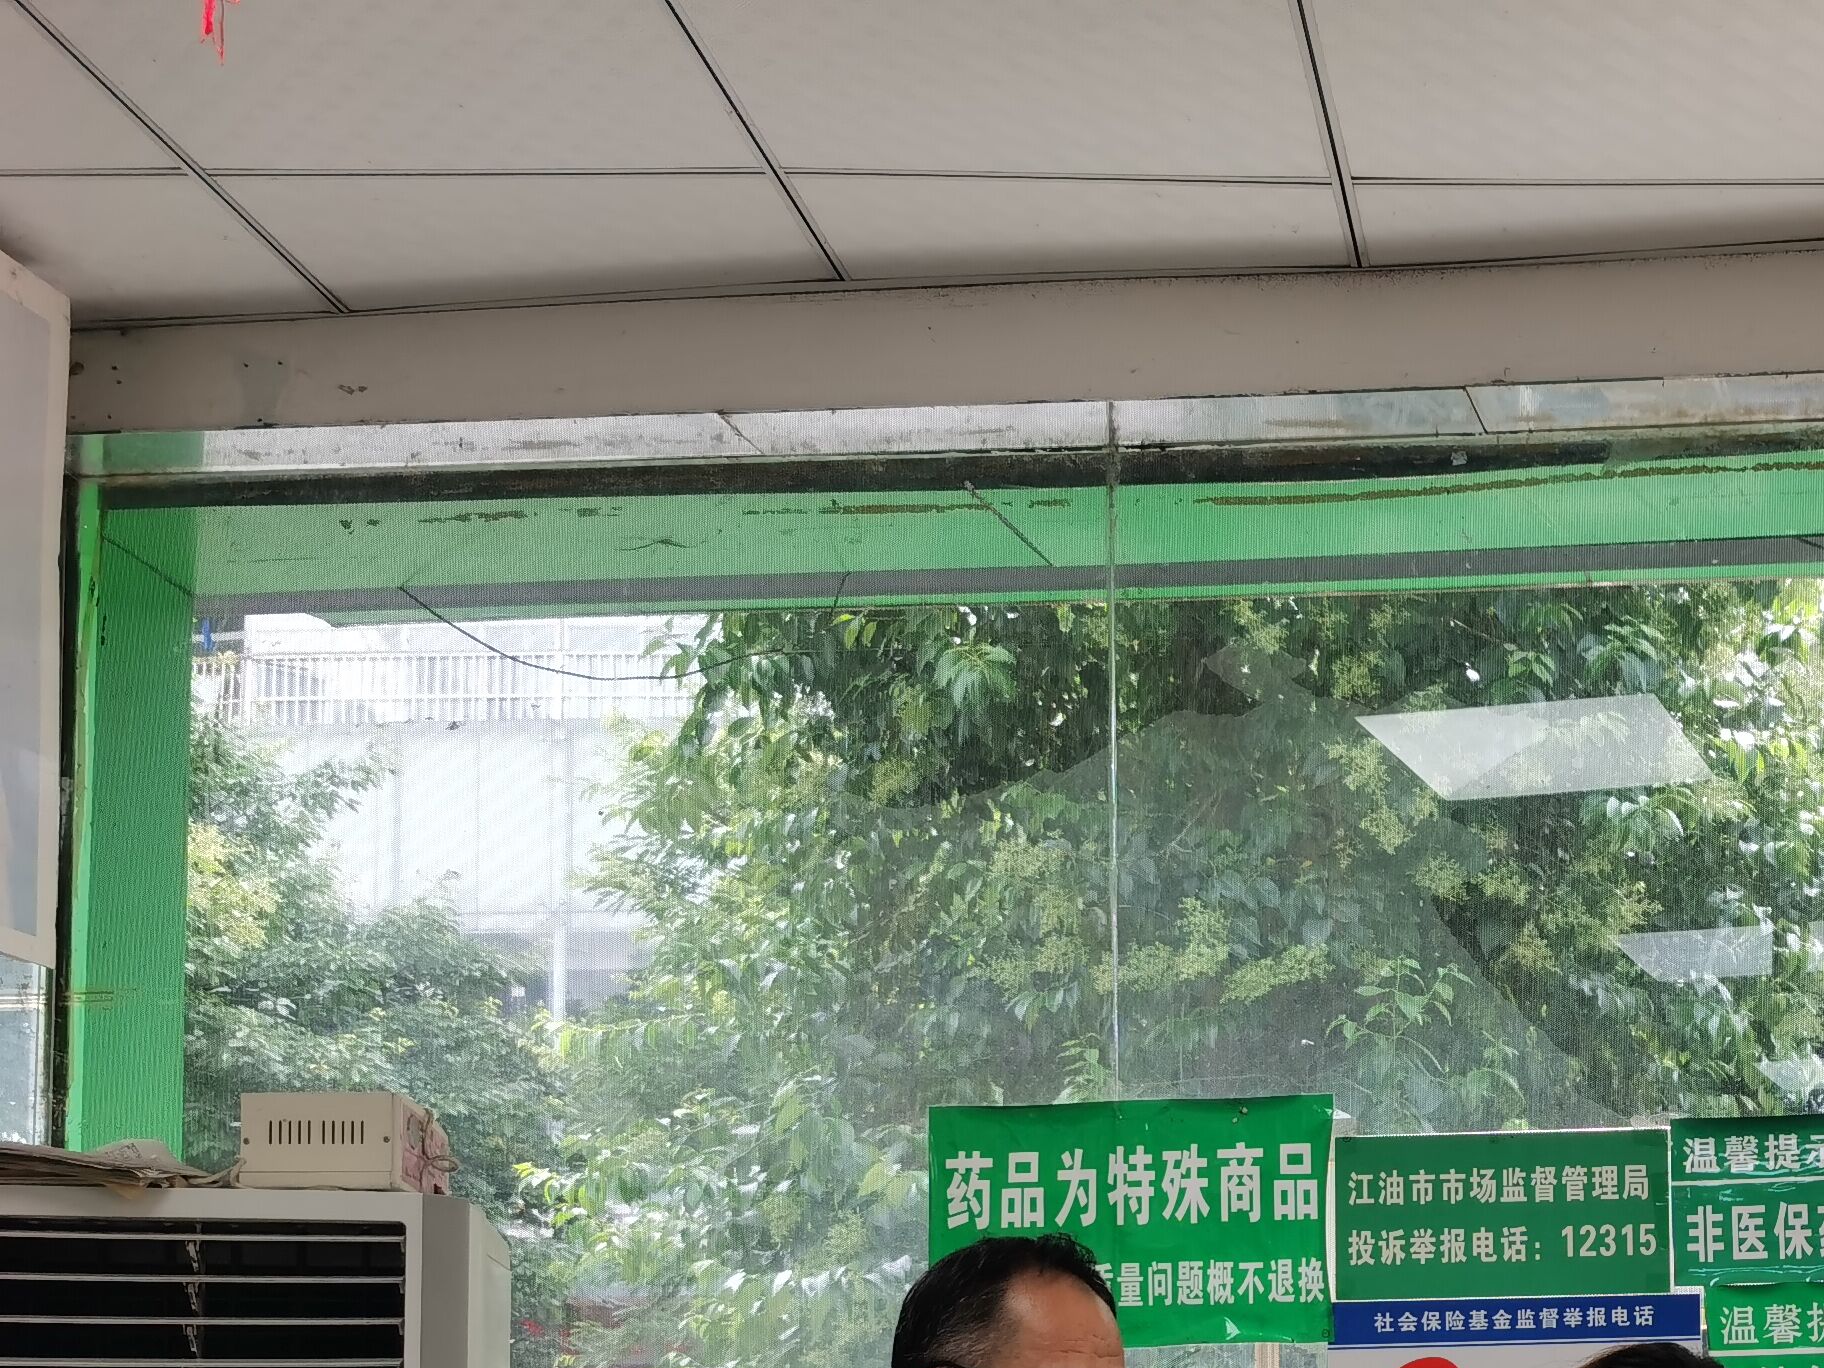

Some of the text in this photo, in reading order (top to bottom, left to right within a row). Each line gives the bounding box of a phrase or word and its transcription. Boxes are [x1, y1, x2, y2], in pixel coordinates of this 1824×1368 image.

[946, 1142, 1319, 1231] 药品为特殊商品
[1347, 1164, 1650, 1207] 江油市市场监督管理局
[1373, 1304, 1655, 1335] 社会保险基金监督举报电话
